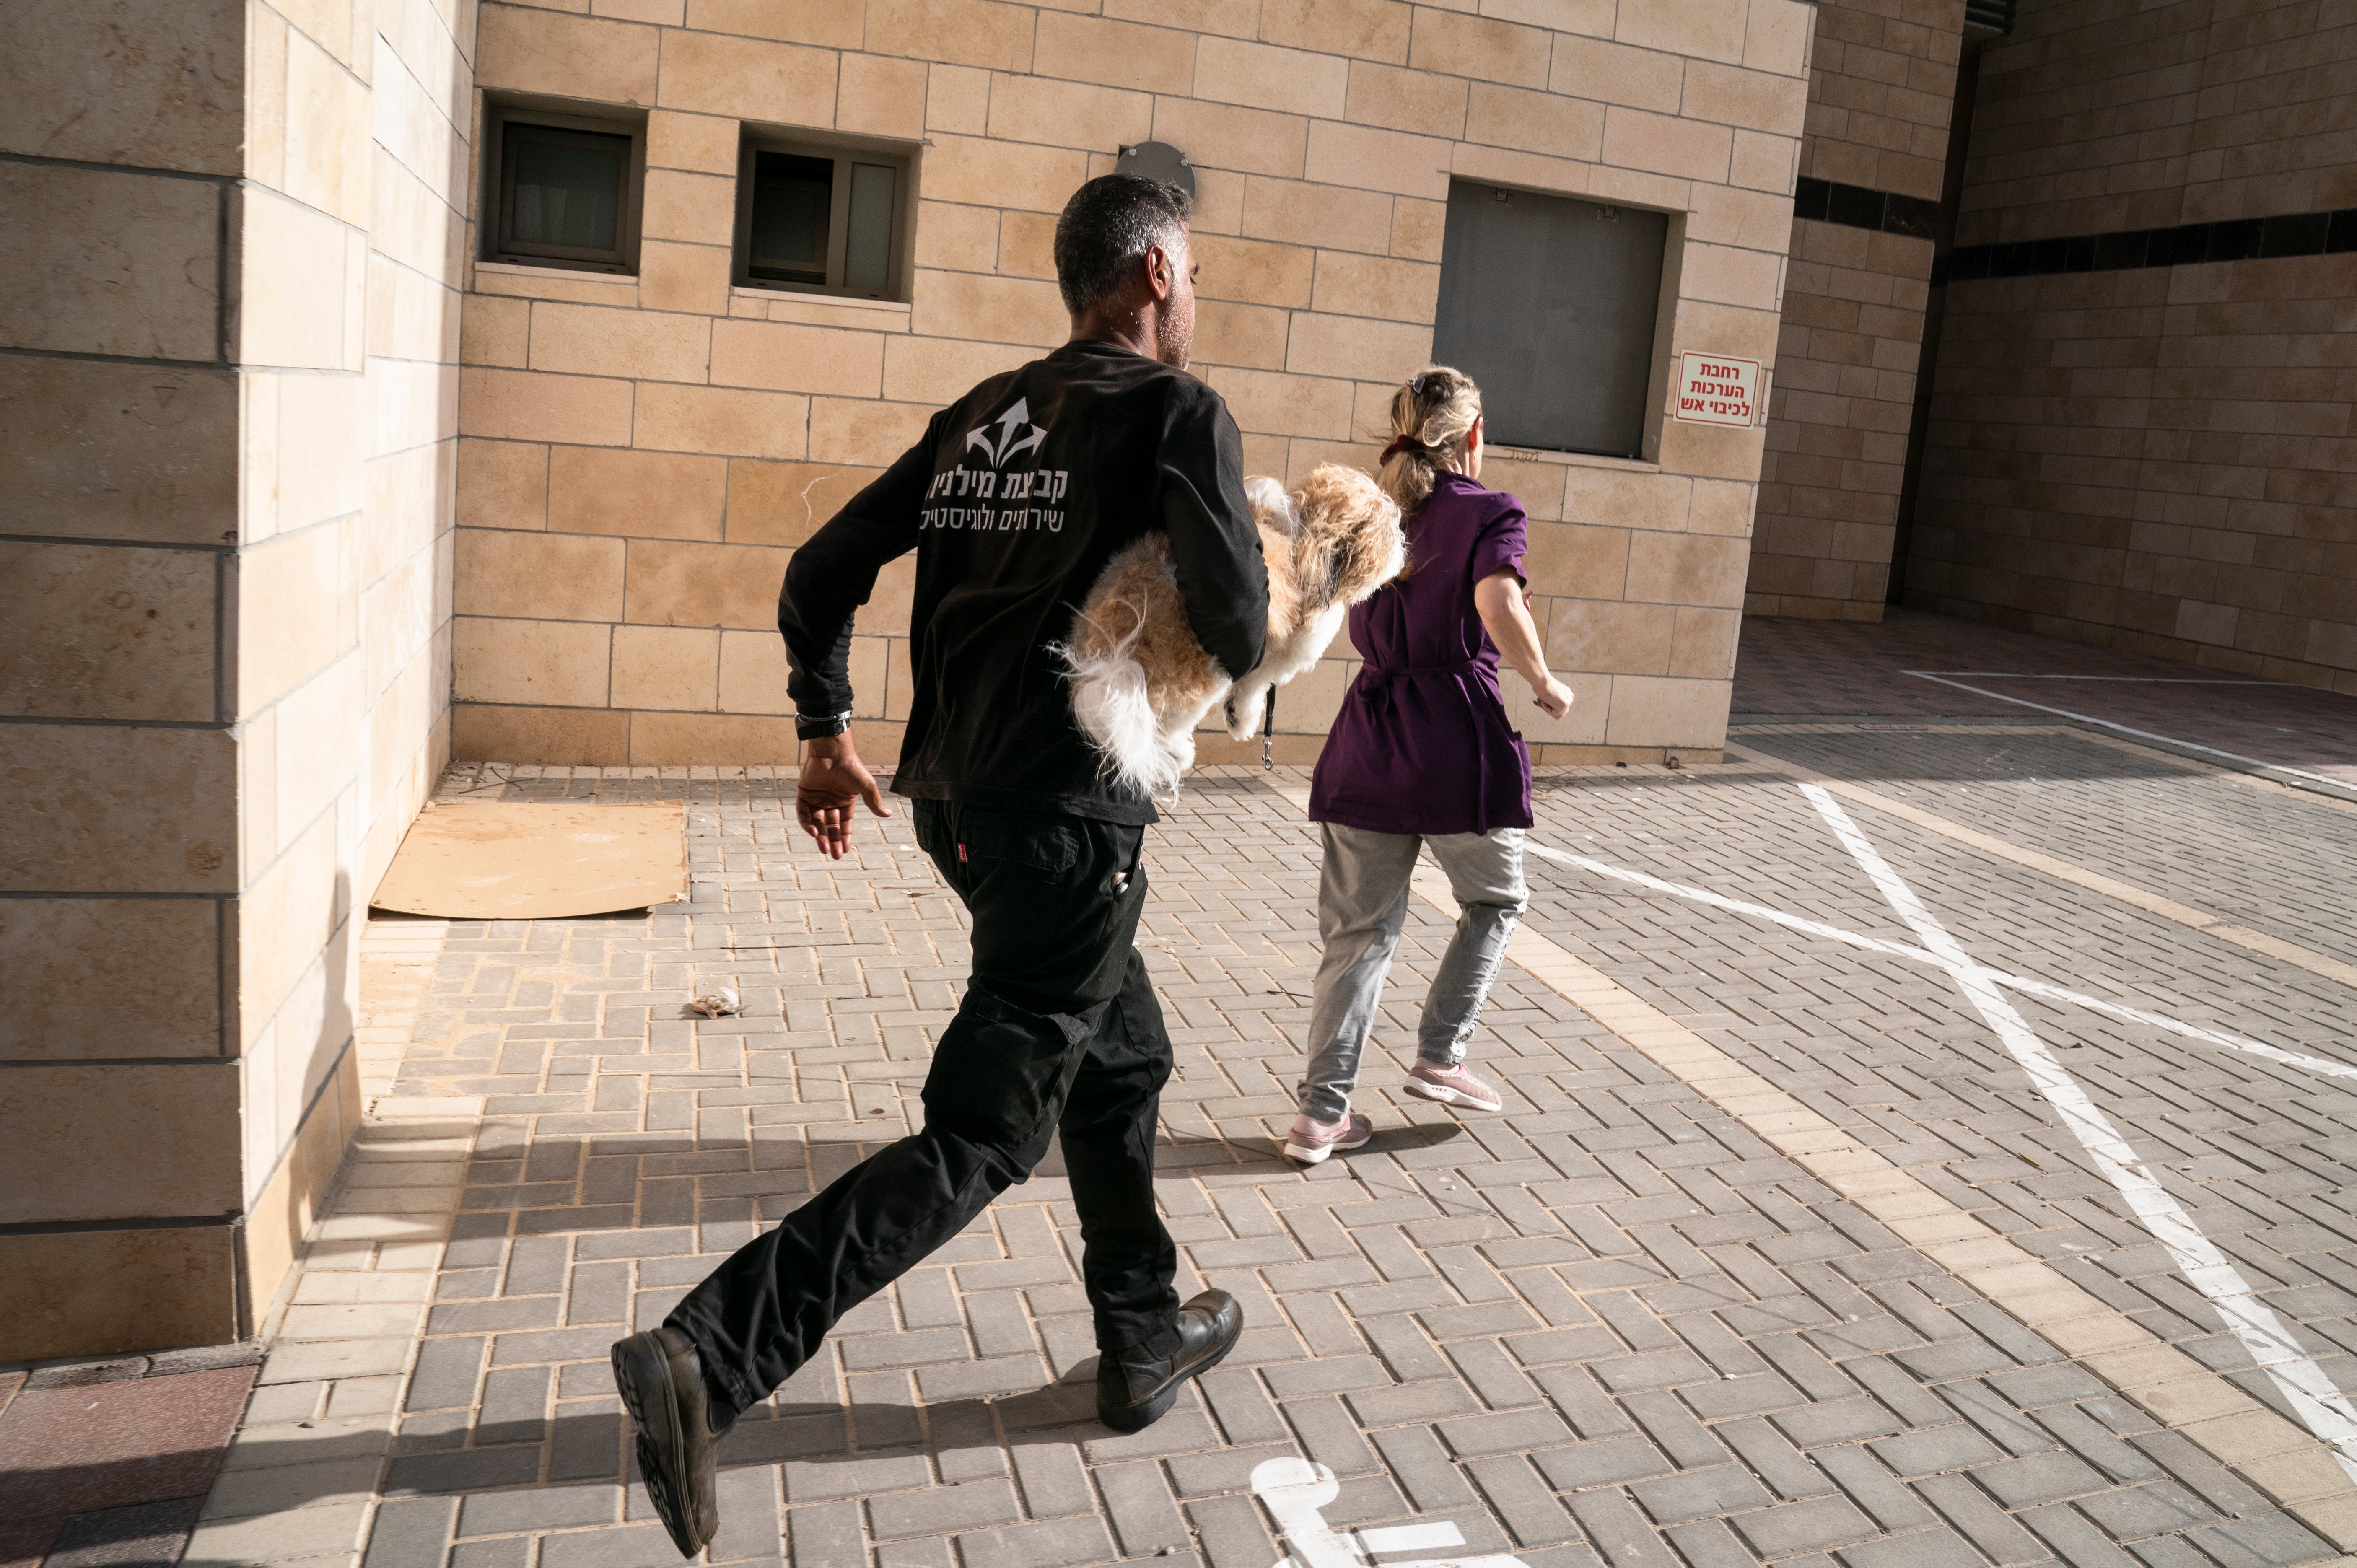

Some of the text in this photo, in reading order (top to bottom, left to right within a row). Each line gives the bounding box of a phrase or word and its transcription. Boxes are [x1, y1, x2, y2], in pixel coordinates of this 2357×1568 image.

[1700, 363, 1740, 380] רחבת
[1690, 380, 1745, 398] הערכות
[1681, 397, 1750, 417] לכיבוי אש
[925, 464, 1068, 504] קבצת מילניו
